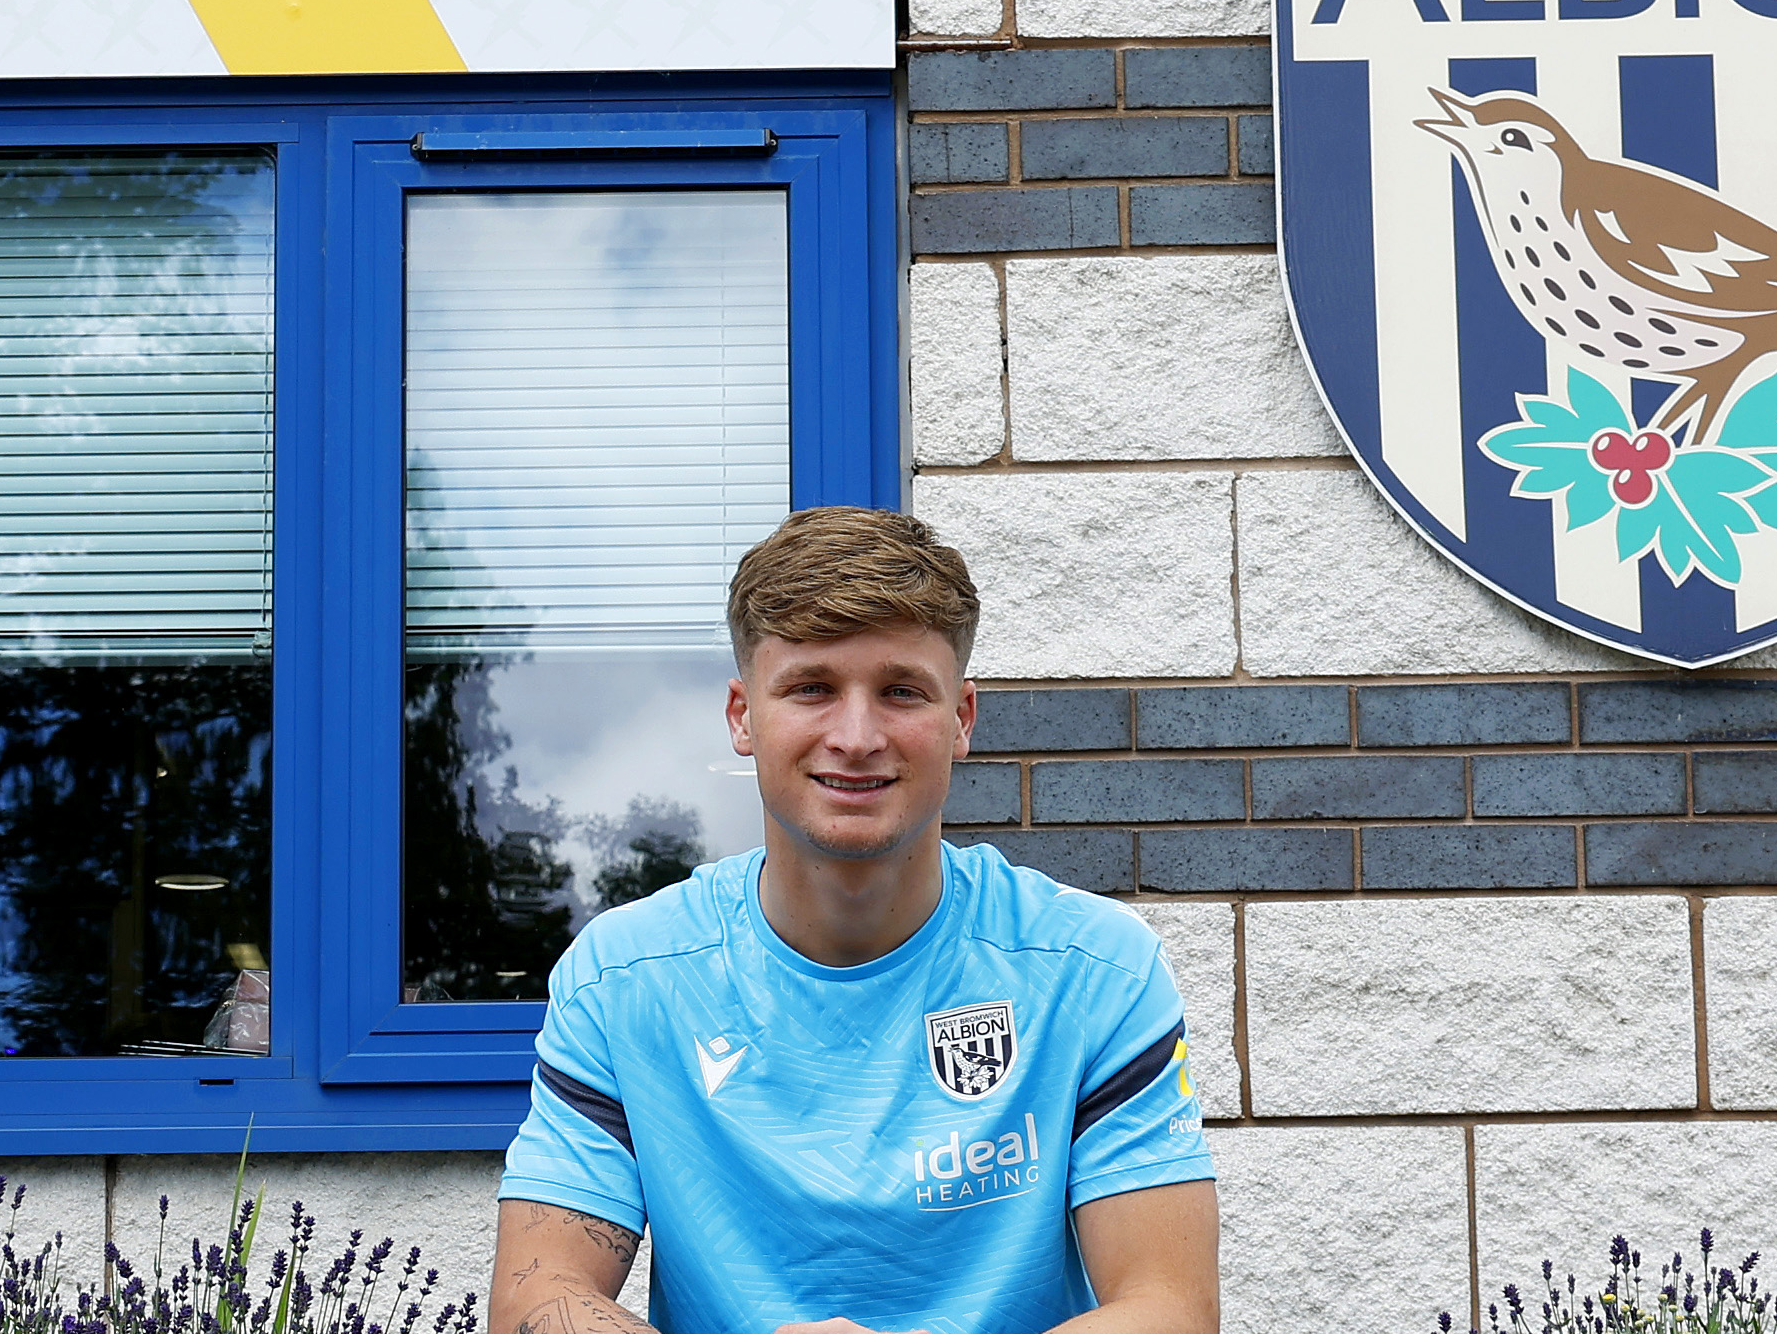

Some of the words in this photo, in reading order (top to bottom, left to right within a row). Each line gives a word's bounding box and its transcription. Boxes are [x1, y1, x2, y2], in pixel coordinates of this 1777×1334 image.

[935, 1018, 958, 1029] WEST
[959, 1010, 1004, 1026] BROMWICH
[936, 1018, 1006, 1044] ALBION
[914, 1112, 1040, 1182] ideal
[915, 1166, 1040, 1204] HEATING
